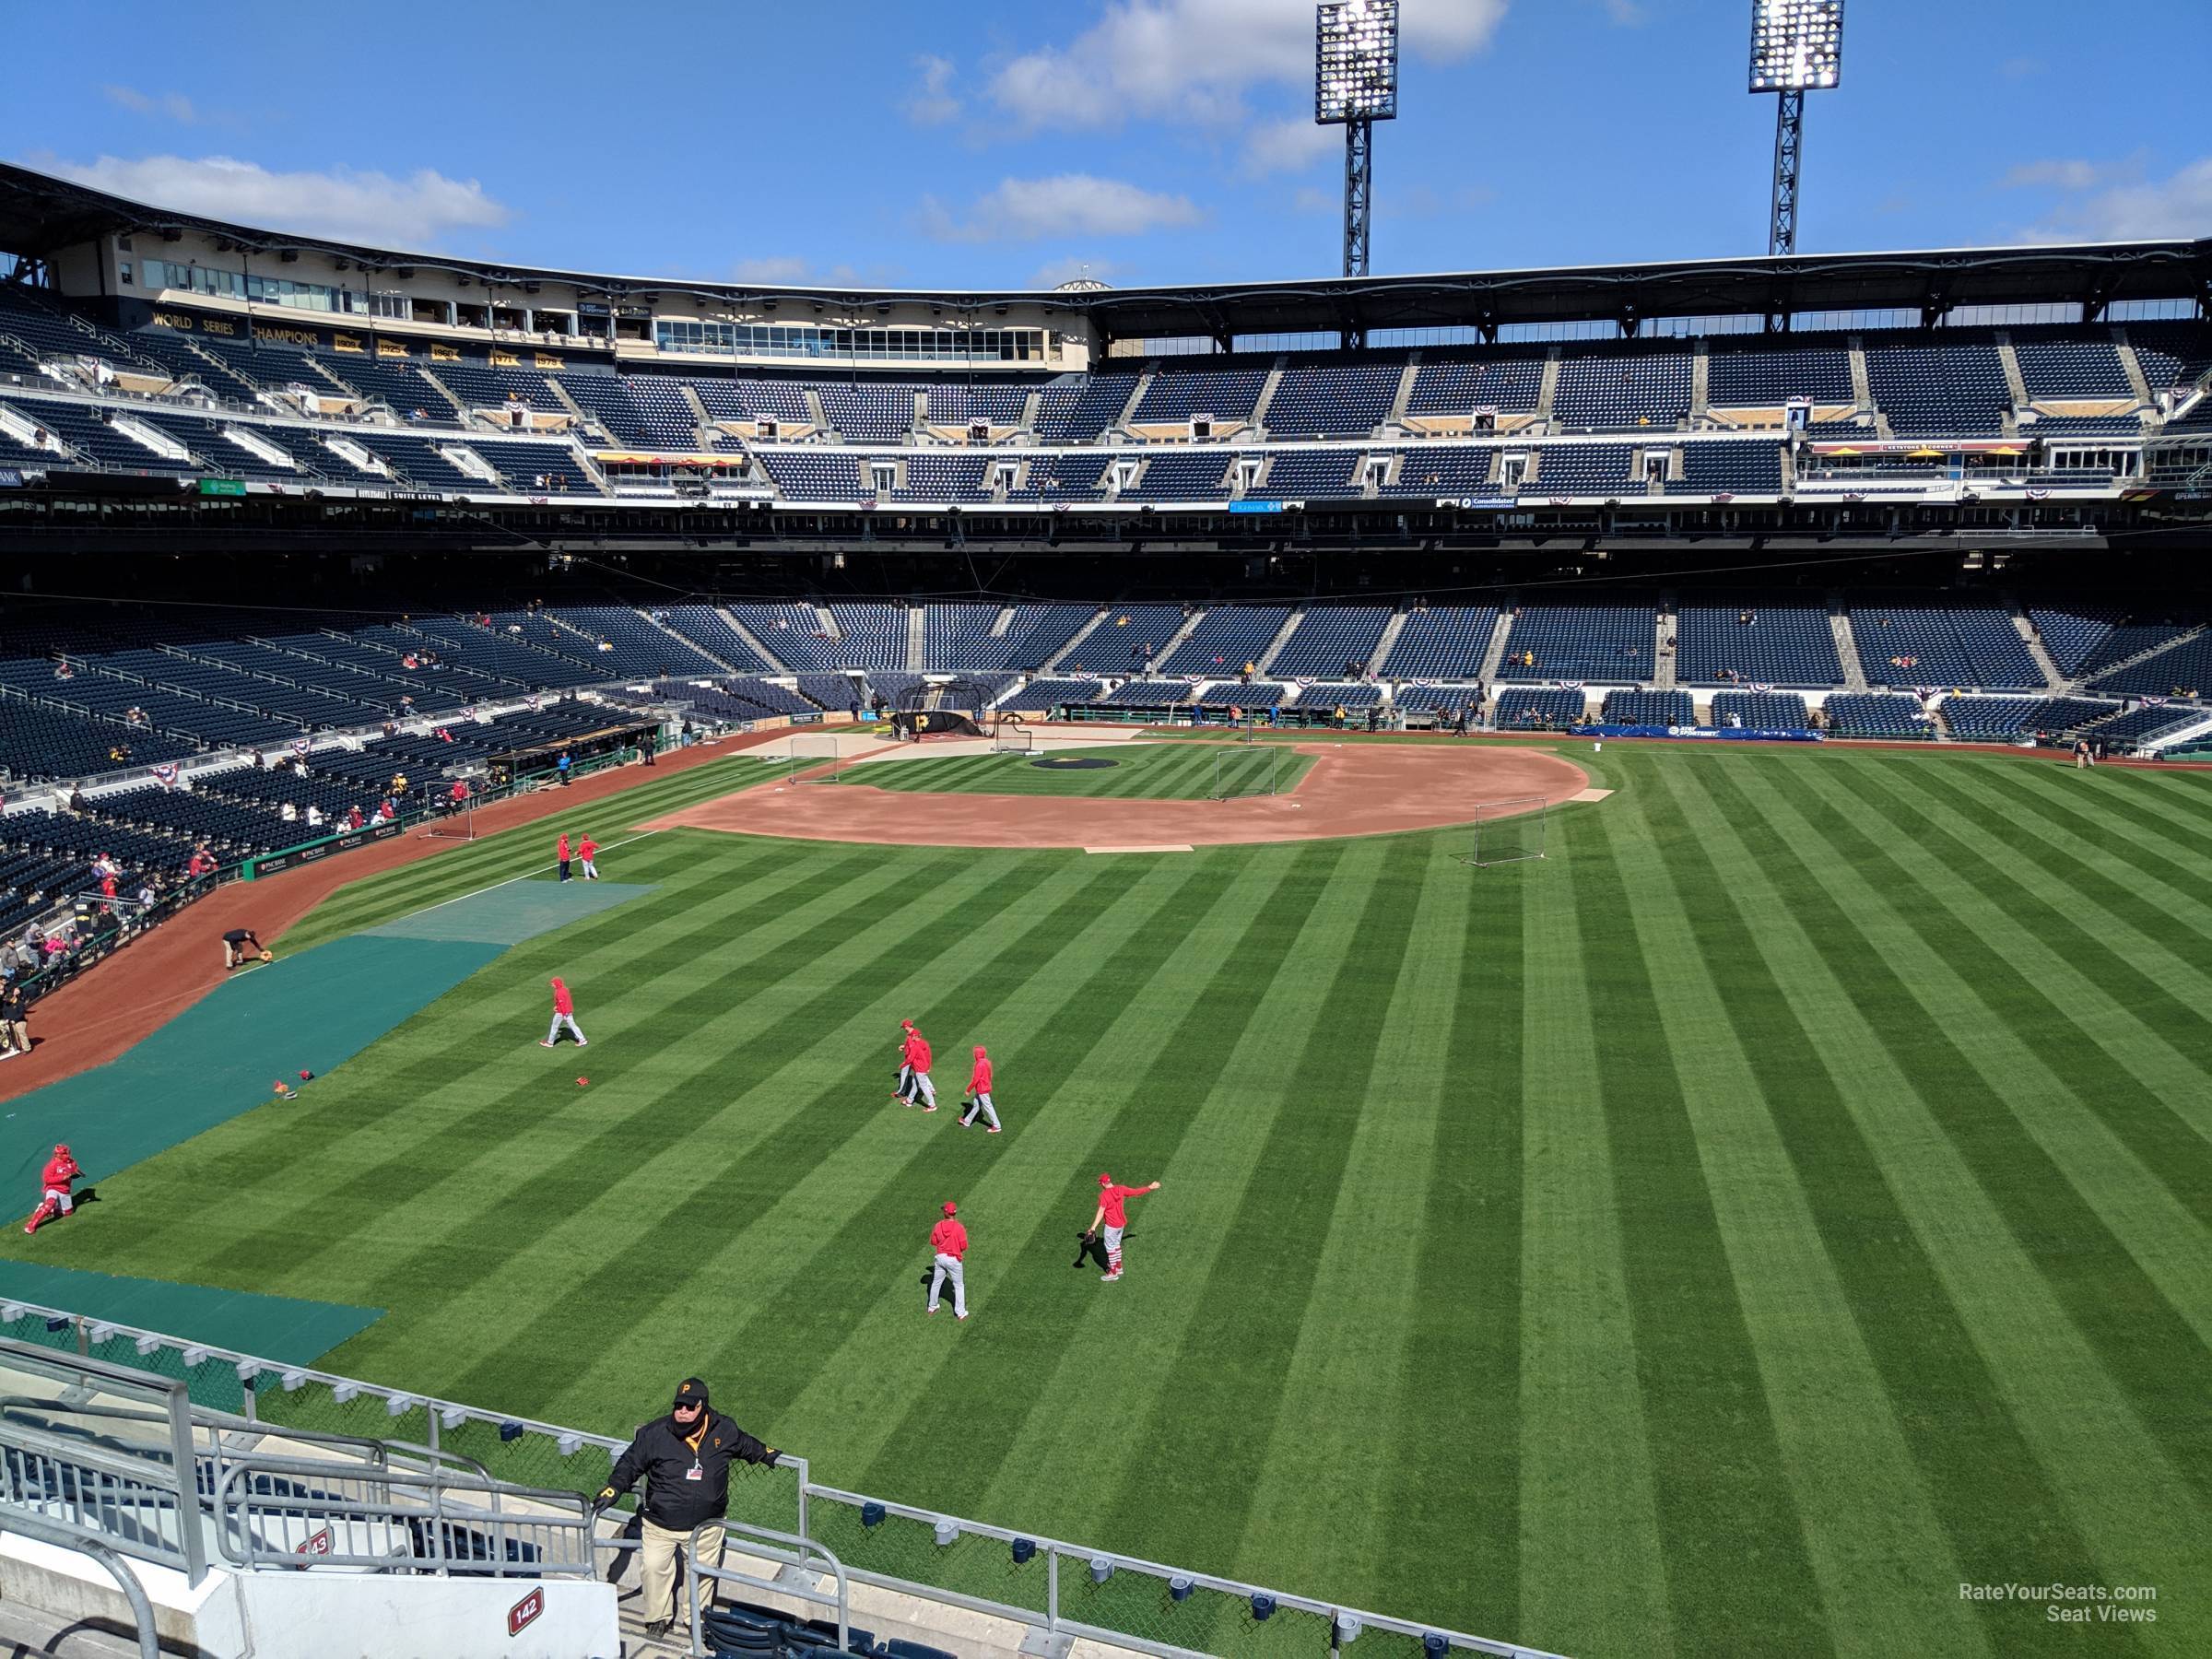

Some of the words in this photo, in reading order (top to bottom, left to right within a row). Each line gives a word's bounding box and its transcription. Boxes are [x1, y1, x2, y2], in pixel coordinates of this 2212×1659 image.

[152, 312, 193, 330] WORLD
[203, 319, 234, 335] SERIES
[251, 326, 319, 346] CHAMPIONS
[380, 344, 401, 353] 1925
[434, 348, 454, 358] 1960
[494, 354, 512, 363] 971
[682, 1384, 690, 1394] P
[714, 1438, 721, 1448] P
[600, 1485, 615, 1498] P
[305, 1537, 327, 1555] 43
[516, 1598, 537, 1624] 142
